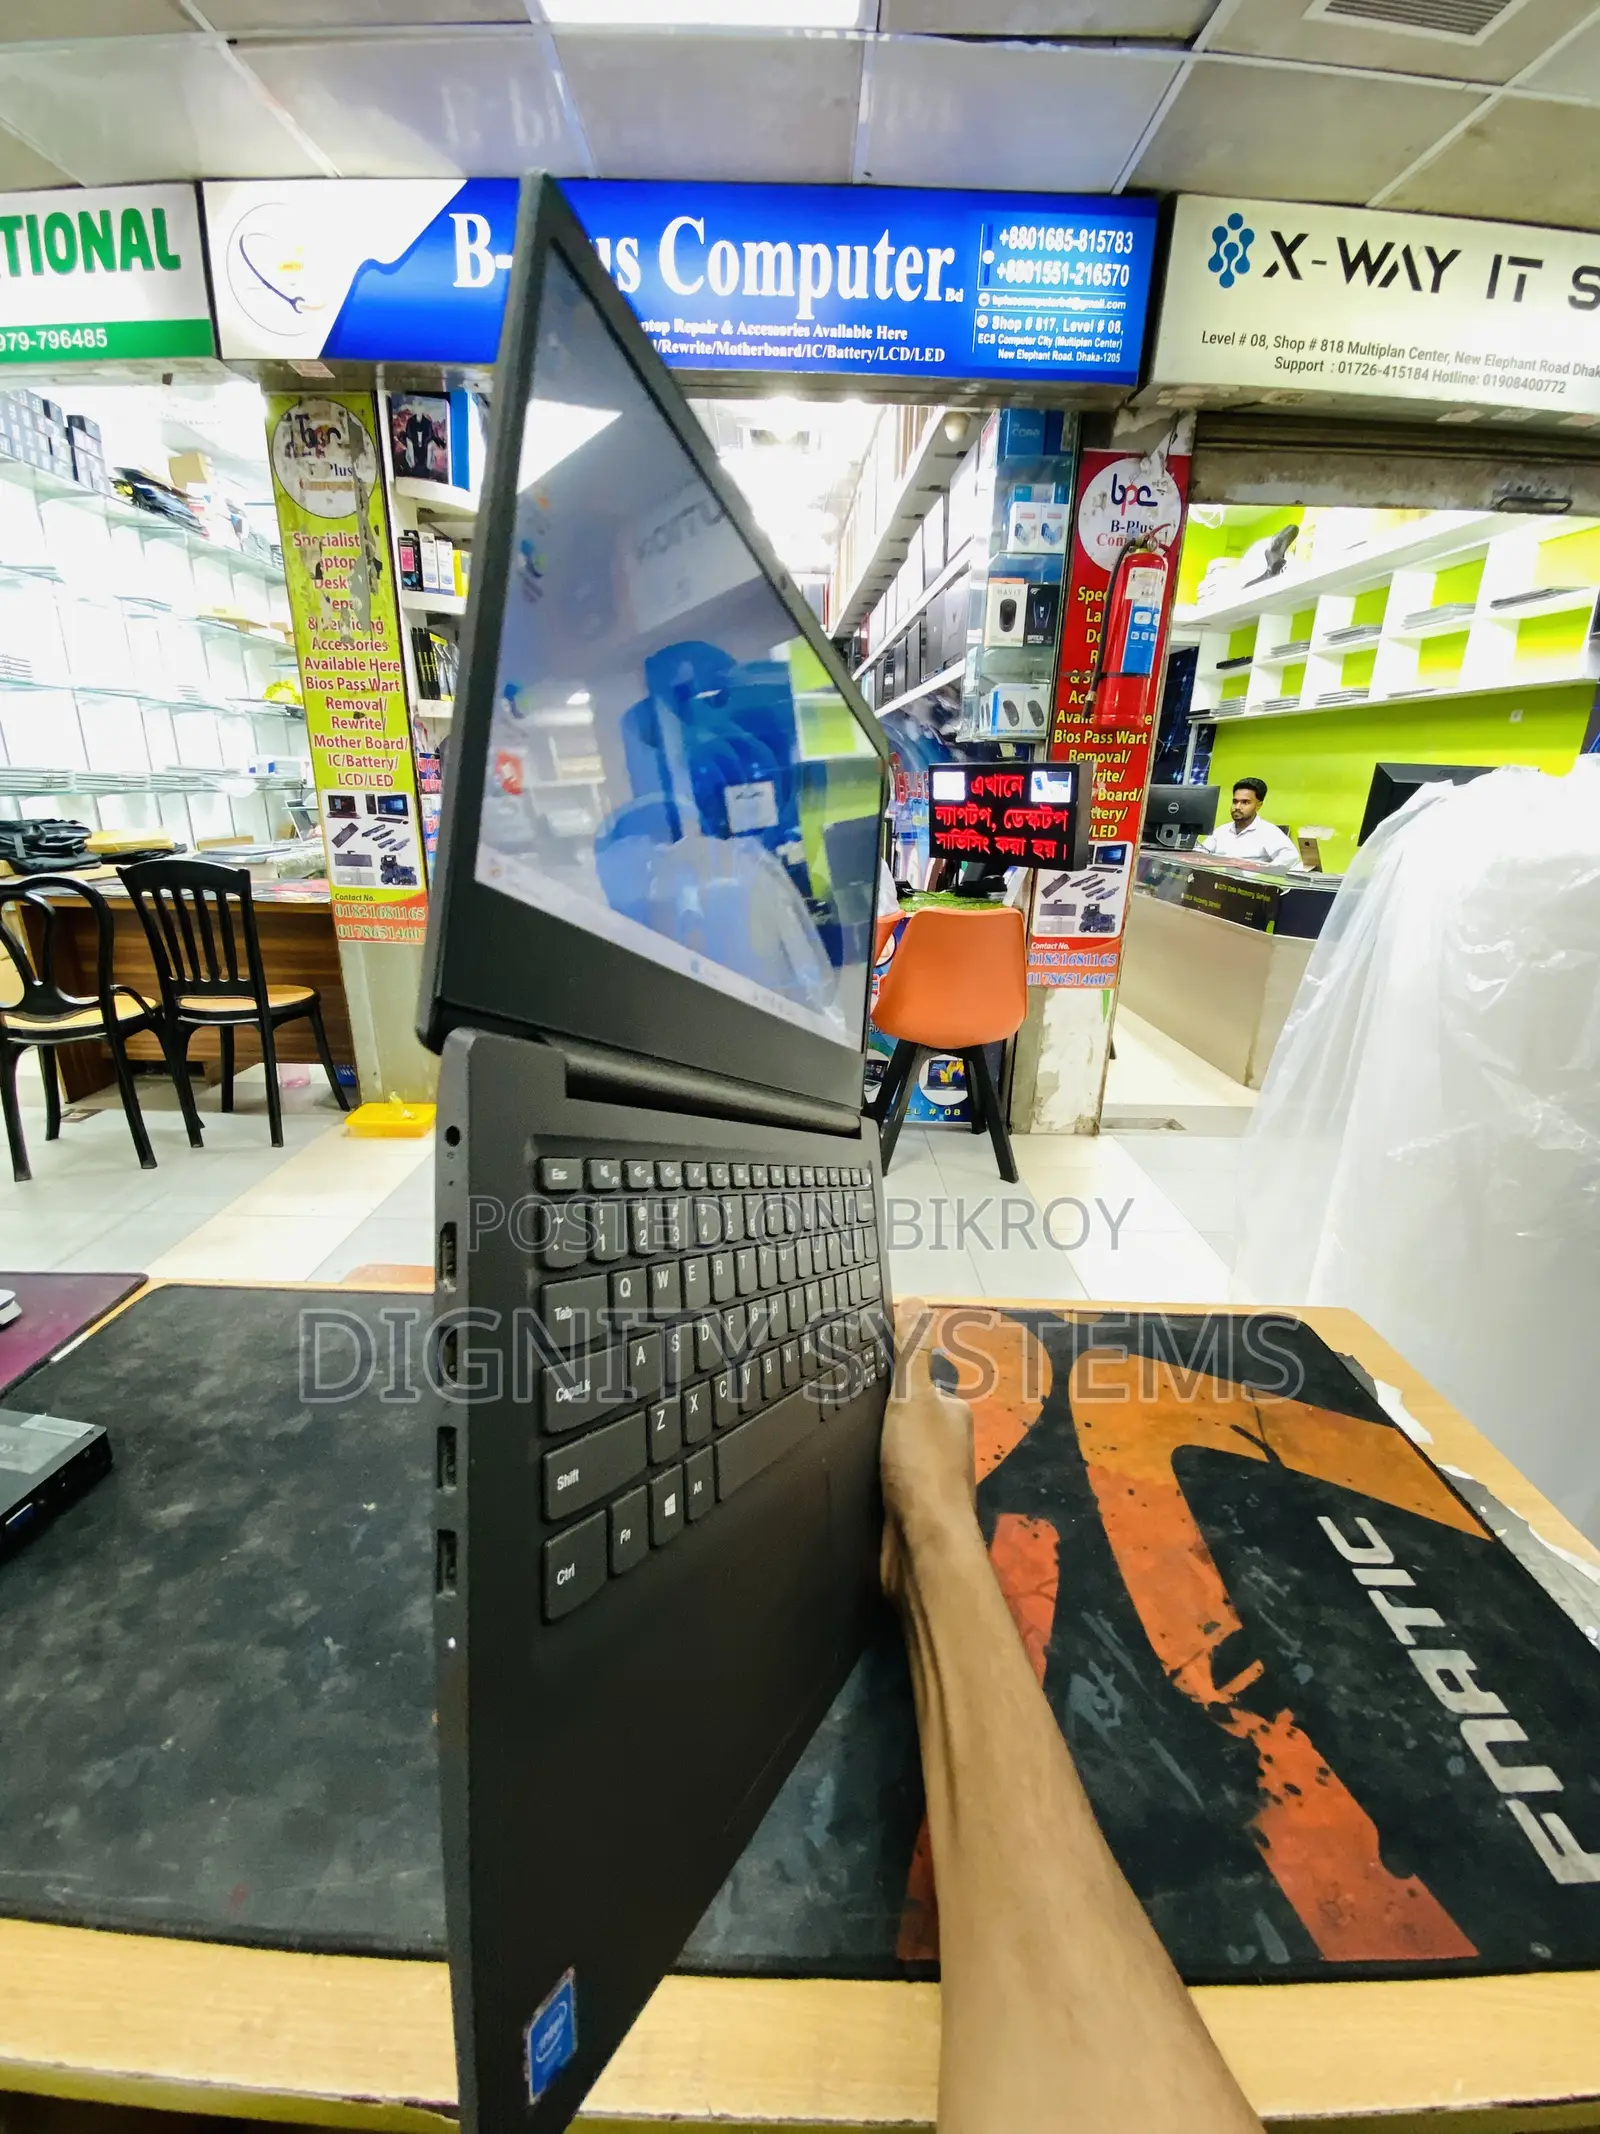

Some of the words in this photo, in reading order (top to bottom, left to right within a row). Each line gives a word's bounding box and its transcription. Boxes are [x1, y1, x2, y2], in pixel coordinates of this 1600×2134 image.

[0, 208, 181, 277] TIONAL
[658, 215, 955, 320] Computer
[1262, 230, 1462, 294] X-WAY
[1485, 253, 1543, 303] IT
[674, 318, 718, 337] Repair
[720, 320, 733, 335] &
[737, 320, 810, 338] Accessories
[813, 324, 873, 340] Available
[876, 325, 908, 340] Here
[991, 315, 1022, 333] Shop
[1025, 316, 1033, 330] #
[1063, 318, 1094, 333] Level
[1097, 319, 1105, 333] #
[1107, 320, 1124, 336] 08,
[998, 334, 1036, 347] Computer
[1037, 335, 1053, 348] City
[1094, 338, 1123, 350] Center)
[998, 349, 1014, 359] New
[1017, 349, 1050, 362] Elephant
[1076, 351, 1121, 363] Dhaka-1205
[1201, 330, 1235, 346] Level
[1239, 333, 1247, 345] #
[1250, 333, 1269, 350] 08,
[1273, 336, 1305, 353] Shop
[1309, 338, 1317, 351] #
[1320, 339, 1344, 353] 818
[1347, 341, 1405, 360] Multiplan
[1409, 346, 1450, 365] Center,
[1454, 351, 1481, 366] New
[1485, 354, 1537, 371] Elephant
[1539, 359, 1570, 375] Road
[1274, 356, 1324, 373] Support
[1337, 360, 1430, 381] 01726-415184
[1432, 369, 1480, 386] Hotline:
[1483, 373, 1567, 394] 01908400772
[312, 637, 388, 651] Accessories
[304, 657, 366, 671] Available
[369, 658, 400, 672] Here
[306, 677, 334, 690] Bios
[337, 677, 366, 691] Pass
[368, 678, 400, 692] Wart
[325, 696, 387, 711] Removal/
[331, 716, 386, 730] Rewrite/
[313, 735, 361, 748] Mother
[365, 736, 408, 750] Board/
[1053, 729, 1081, 743] Bios
[1084, 730, 1113, 744] Pass
[1116, 731, 1147, 744] Wart
[328, 754, 398, 771] IC/Battery/
[338, 773, 394, 787] LCD/LED
[970, 773, 1024, 799] এখানে
[1097, 788, 1143, 802] Board/
[994, 836, 1026, 857] করা
[335, 893, 361, 901] Contact
[363, 894, 375, 902] No.
[1031, 942, 1057, 950] Contact
[1059, 942, 1070, 950] No.
[551, 1168, 567, 1180] Esc
[554, 1306, 573, 1321] Tab
[619, 1278, 631, 1299] Q
[657, 1270, 669, 1289] W
[688, 1265, 696, 1281] E
[715, 1260, 723, 1276] R
[740, 1255, 746, 1270] T
[761, 1250, 768, 1265] Y
[635, 1346, 646, 1365] A
[671, 1333, 680, 1351] S
[701, 1324, 709, 1341] D
[728, 1316, 734, 1331] F
[751, 1306, 758, 1322] G
[771, 1300, 778, 1315] H
[556, 1467, 580, 1490] Shift
[655, 1409, 666, 1431] Z
[690, 1394, 698, 1413] X
[719, 1380, 727, 1398] C
[744, 1368, 750, 1385] V
[765, 1358, 772, 1374] B
[785, 1348, 792, 1363] N
[556, 1562, 575, 1586] Ctrl
[620, 1528, 631, 1544] Fn
[1317, 1516, 1600, 1884] FNATIC
